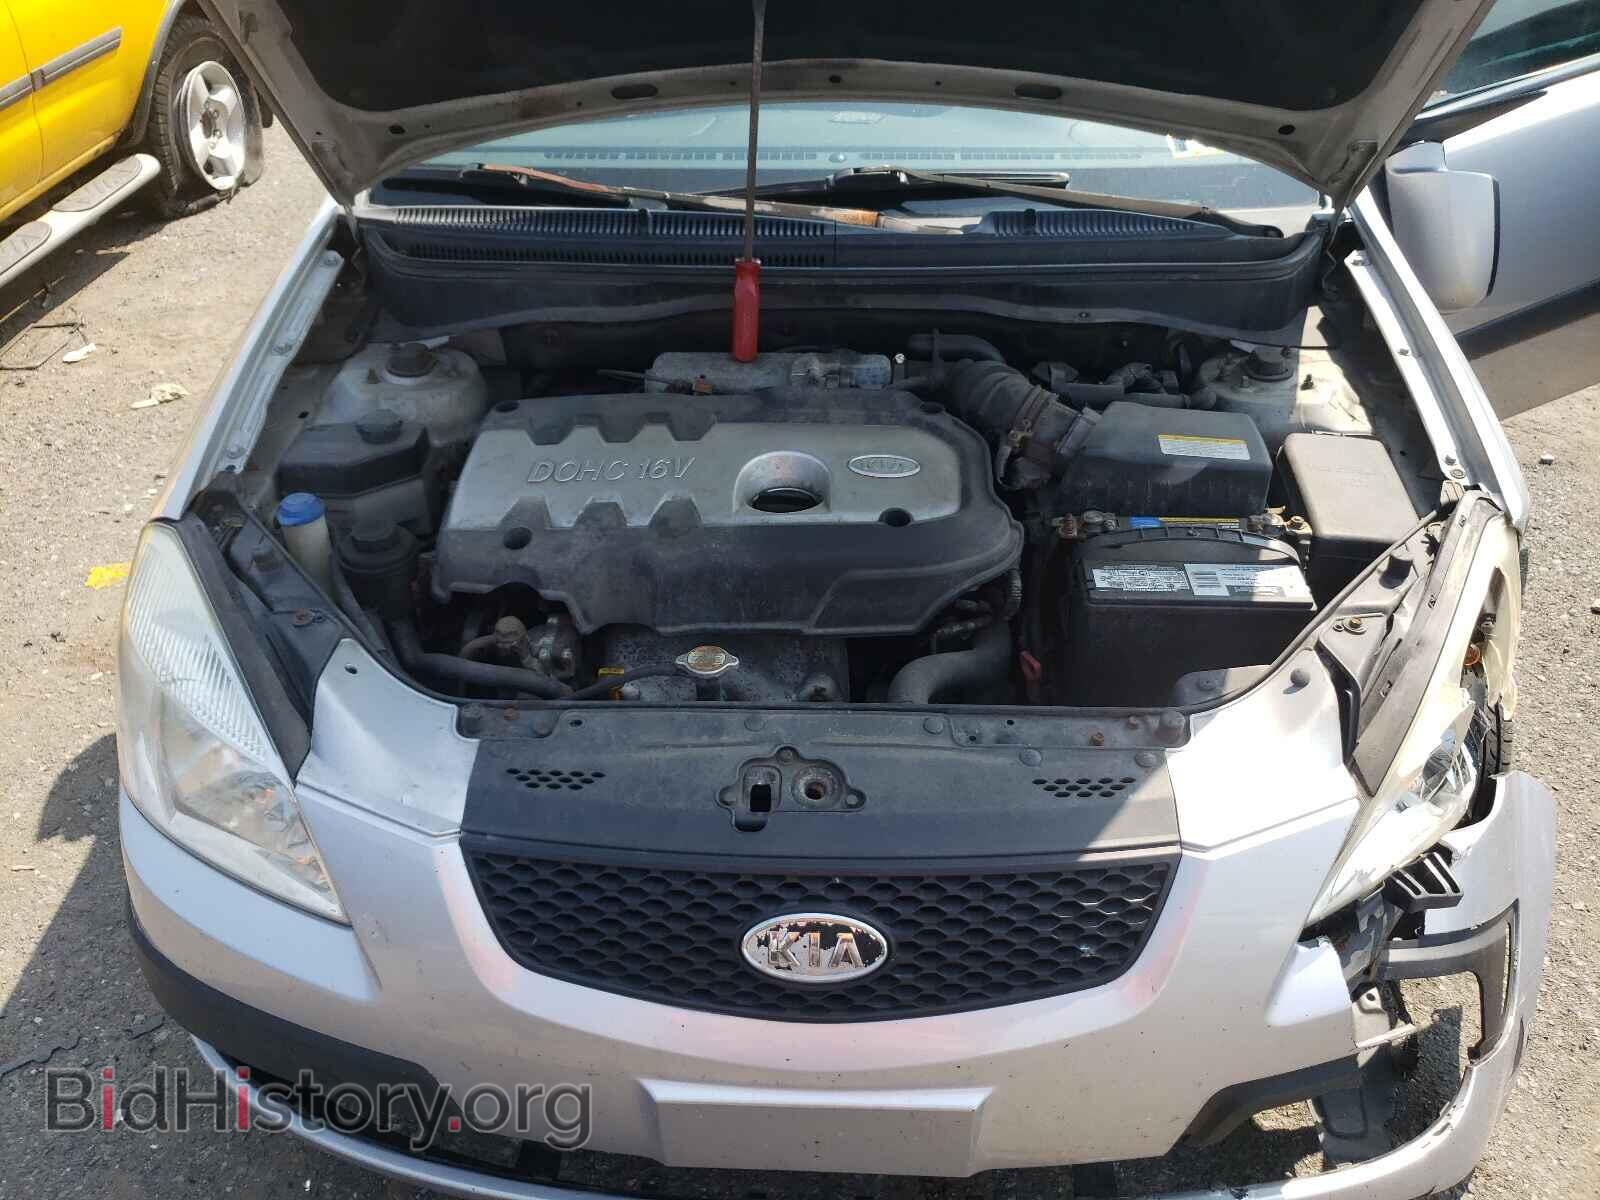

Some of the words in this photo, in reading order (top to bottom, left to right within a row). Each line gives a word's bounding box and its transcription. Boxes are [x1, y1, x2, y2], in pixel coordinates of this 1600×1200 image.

[527, 459, 629, 483] DOHC
[637, 456, 696, 480] 16V
[767, 930, 865, 969] KIA
